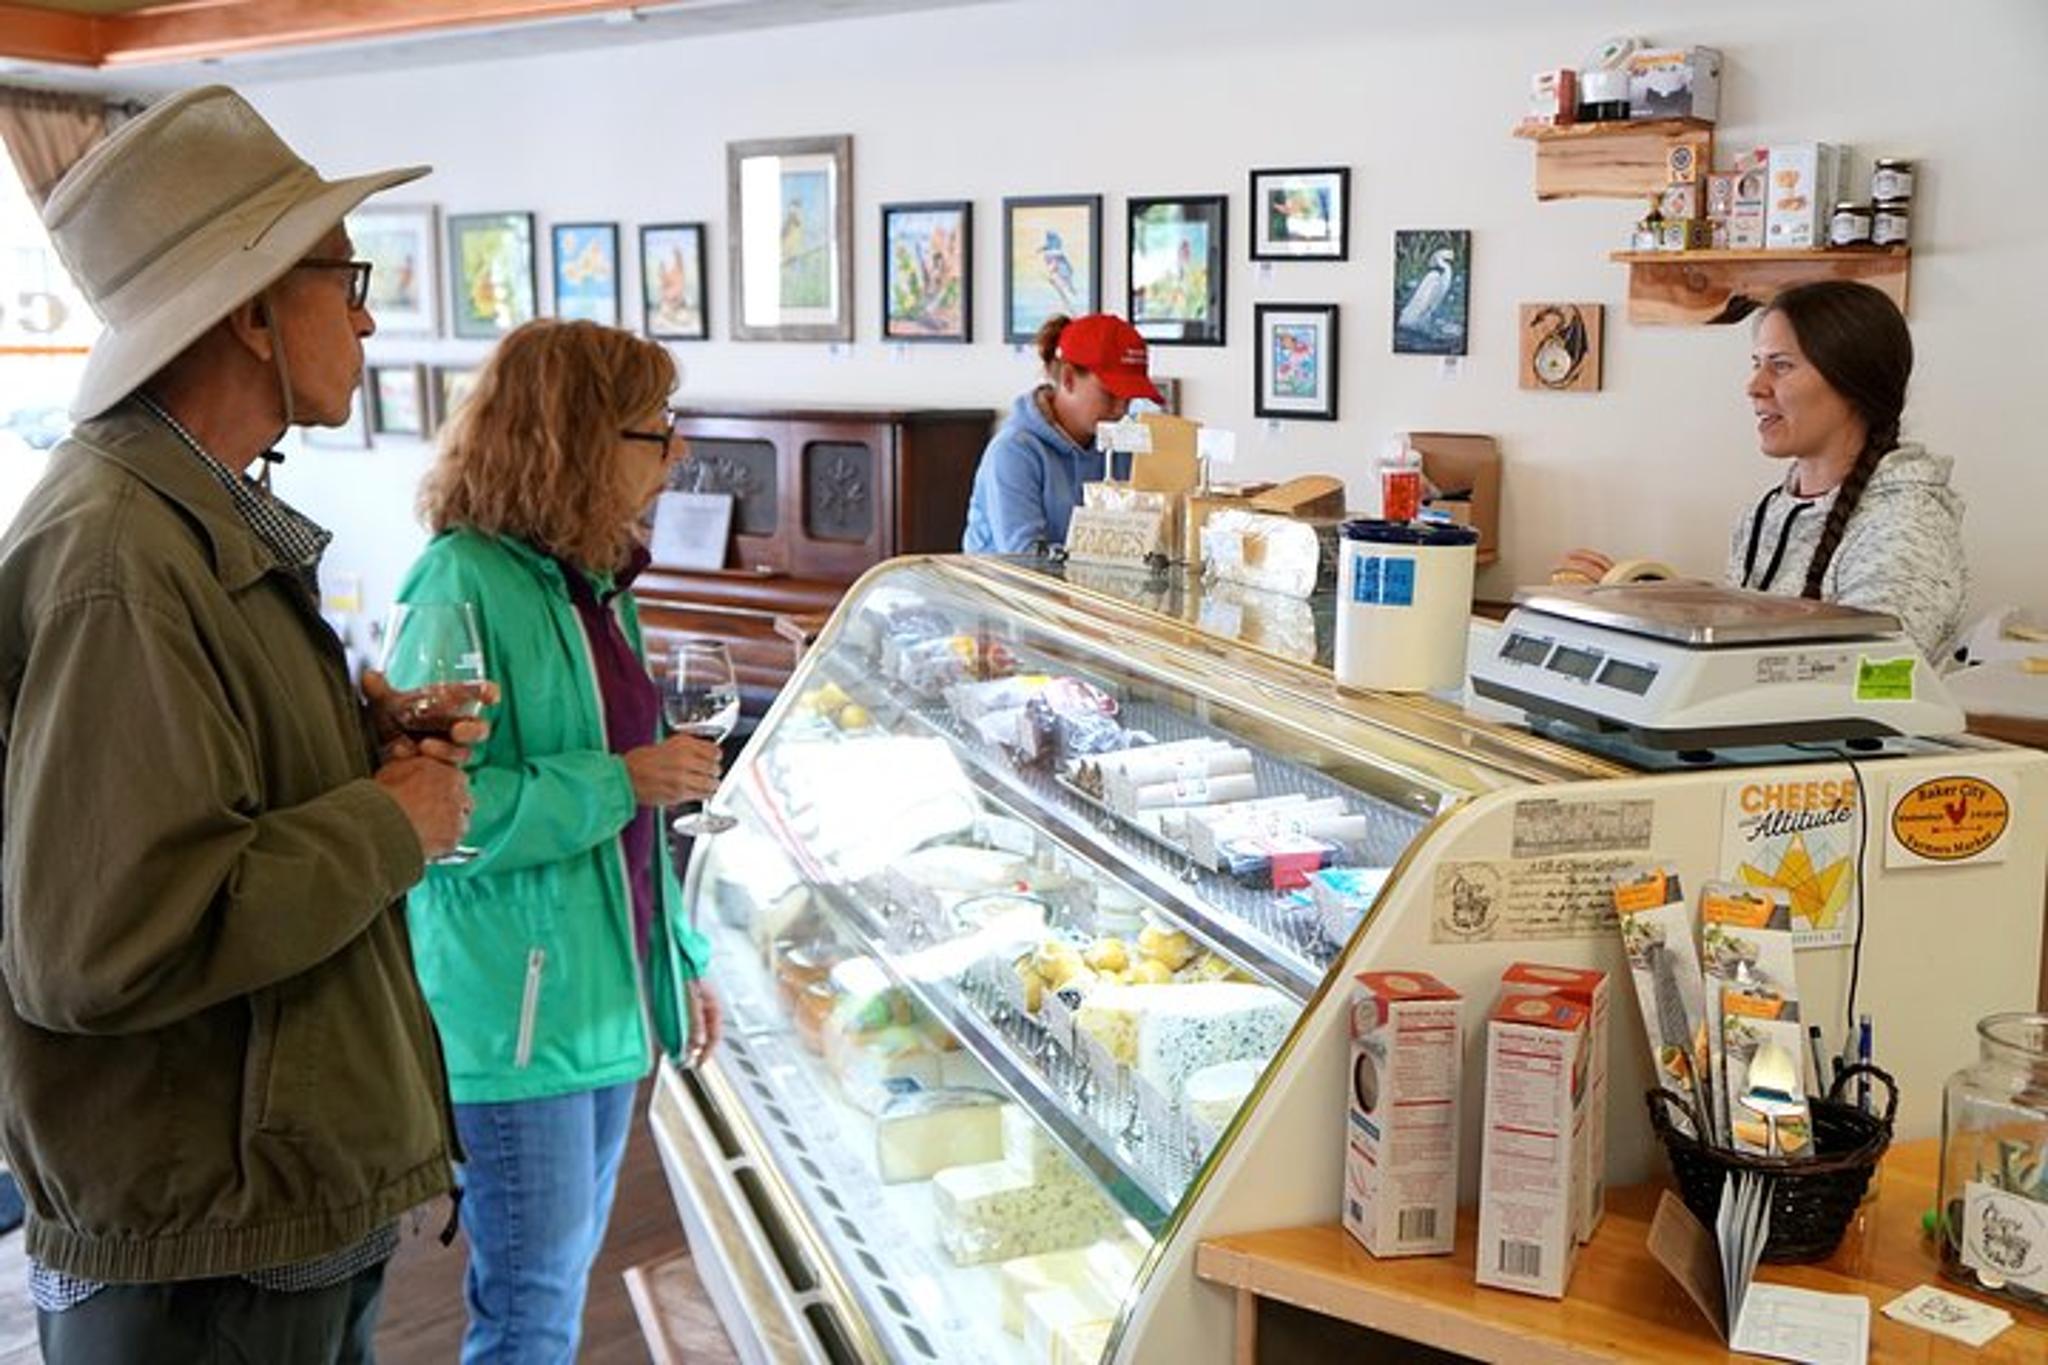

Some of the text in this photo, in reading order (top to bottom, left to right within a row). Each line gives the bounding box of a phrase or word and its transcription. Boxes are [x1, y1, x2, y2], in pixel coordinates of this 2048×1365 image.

[1740, 779, 1858, 814] CHEESE
[1918, 783, 1986, 802] Baker City
[1746, 799, 1852, 841] Altitude
[1907, 832, 1993, 854] Farmers Market
